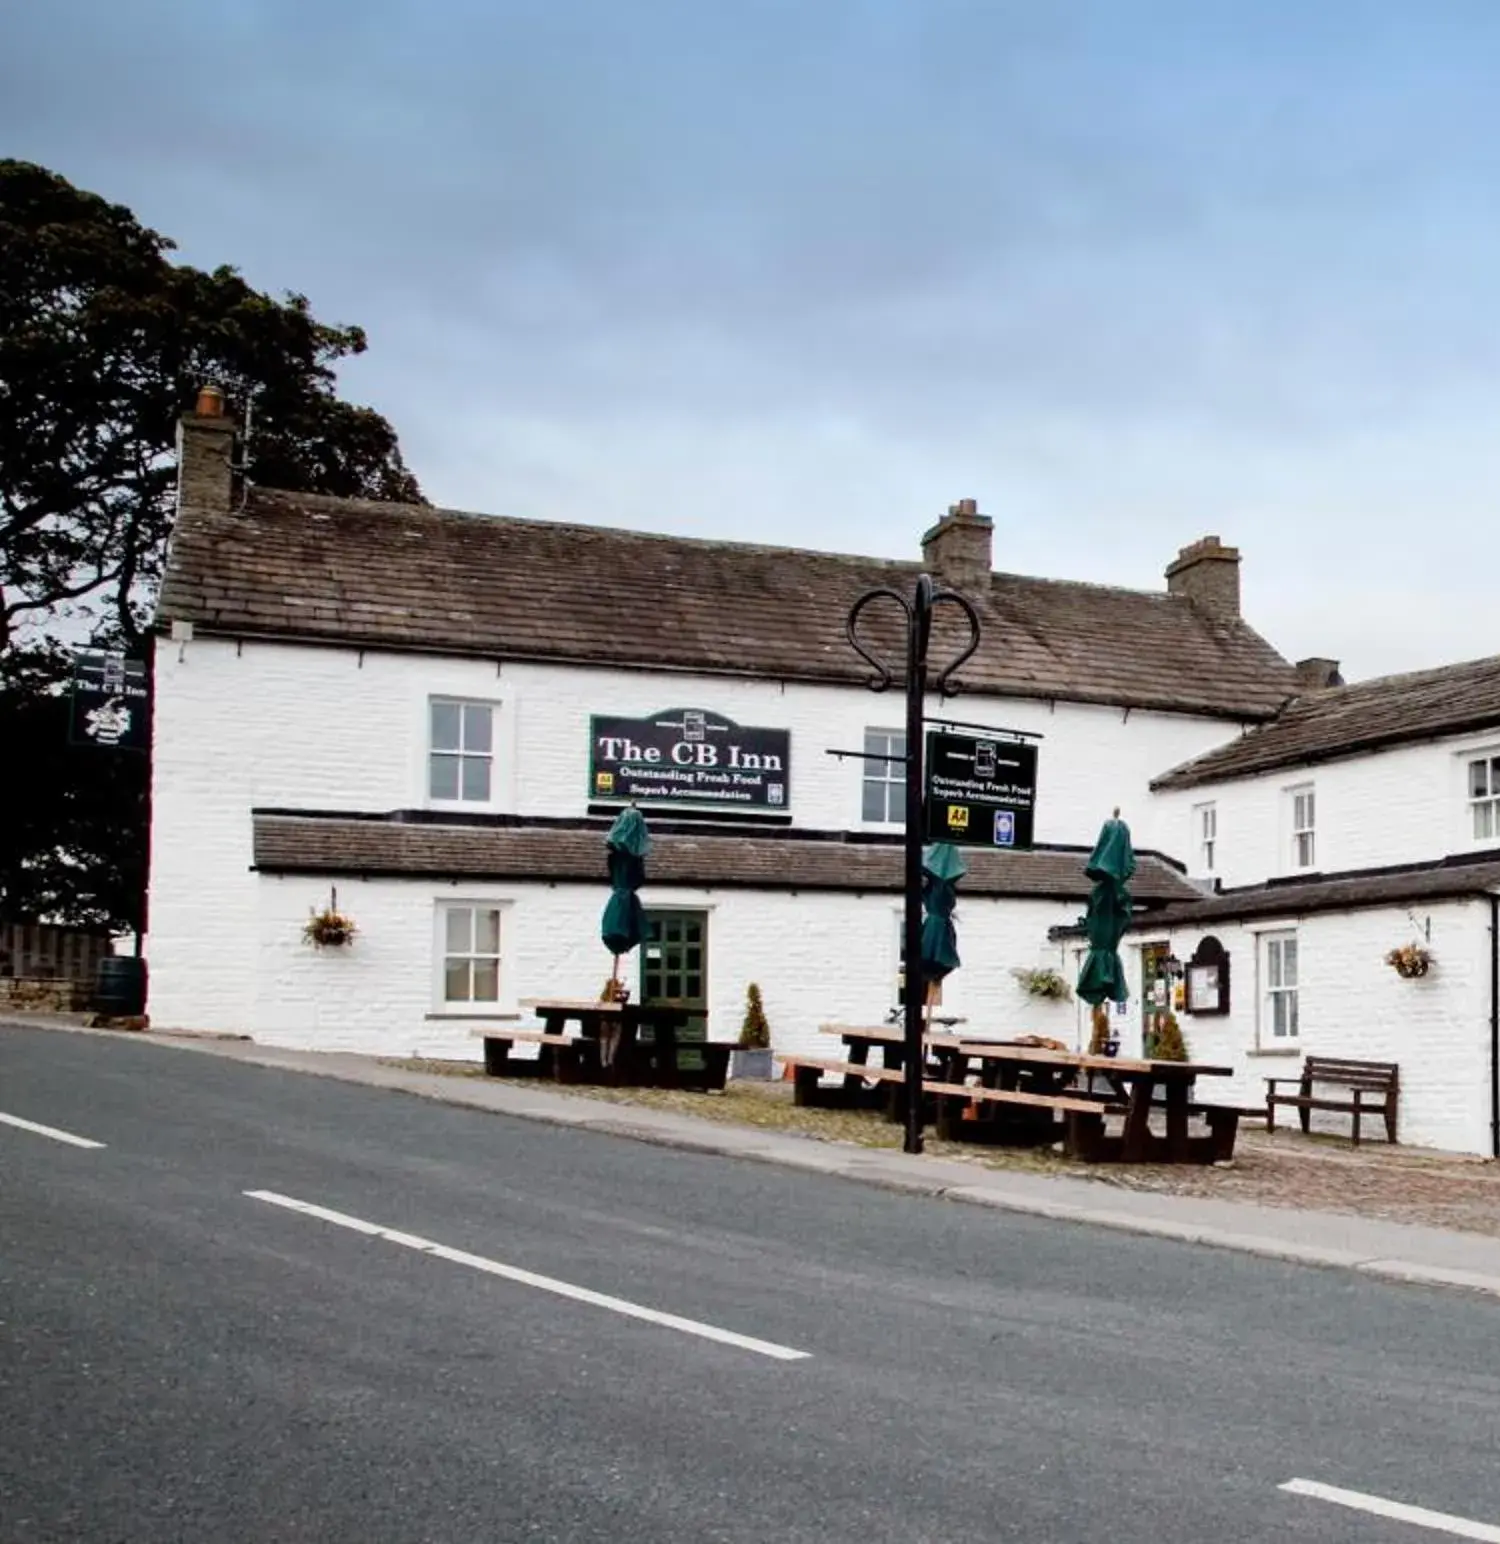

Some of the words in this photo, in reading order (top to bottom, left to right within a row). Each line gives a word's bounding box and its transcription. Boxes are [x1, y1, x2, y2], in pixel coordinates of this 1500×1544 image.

[76, 679, 99, 690] The
[599, 737, 661, 763] The
[671, 741, 718, 767] CB
[728, 745, 782, 771] Inn
[620, 767, 694, 783] Outstanding
[697, 772, 729, 784] Fresh
[733, 774, 762, 785] Food
[629, 783, 669, 795] Superb
[932, 775, 984, 791] Outstanding
[986, 781, 1009, 792] Fresh
[1011, 784, 1031, 796] Food
[933, 786, 963, 798] Superb
[951, 809, 967, 821] AA
